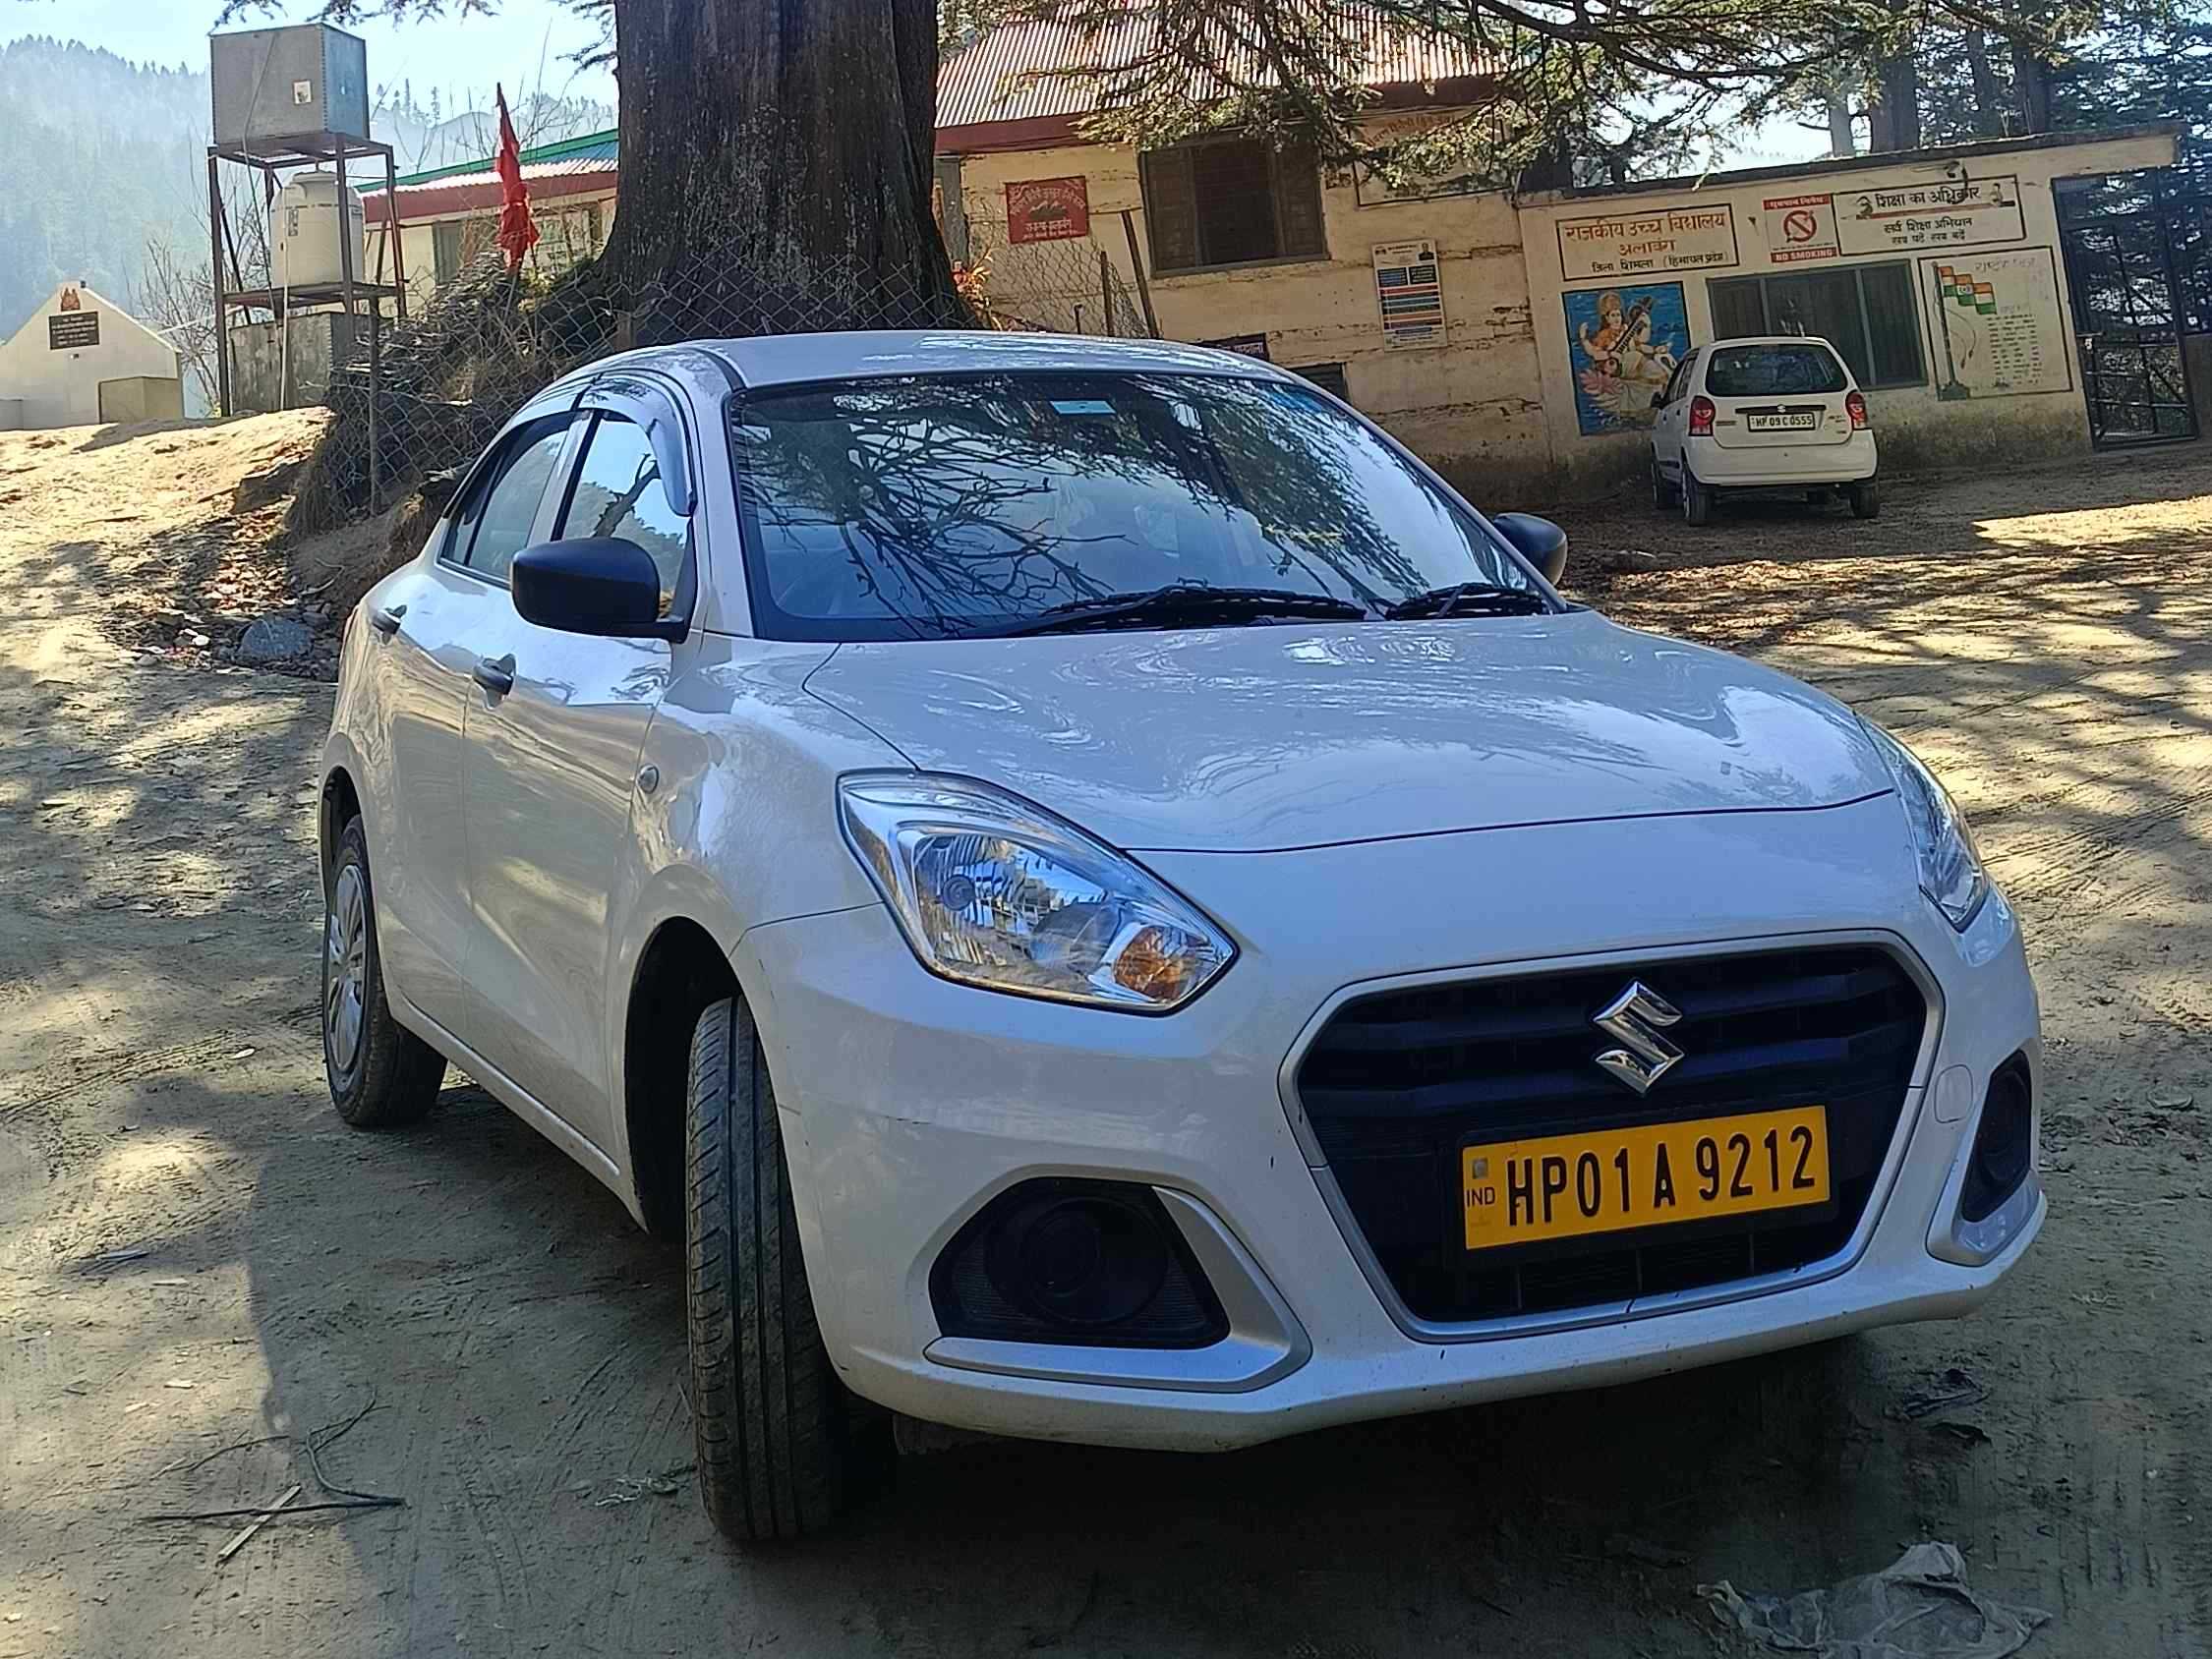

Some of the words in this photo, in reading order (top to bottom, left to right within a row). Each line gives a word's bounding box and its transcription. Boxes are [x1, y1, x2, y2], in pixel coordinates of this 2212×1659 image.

[1875, 192, 1905, 208] शिक्षा
[1909, 191, 1926, 204] का
[1565, 217, 1624, 242] राजकीय
[1628, 218, 1663, 237] उच्च
[1667, 211, 1725, 233] विद्यालय
[1906, 218, 1932, 232] शिक्षा
[1934, 215, 1973, 229] अभियान
[1620, 257, 1654, 270] शिमला
[1775, 253, 1789, 261] NO
[1790, 250, 1833, 260] SMOKING
[1506, 1146, 1631, 1227] HP01
[1653, 1142, 1676, 1209] A
[1694, 1124, 1816, 1201] 9212
[1466, 1186, 1496, 1209] IND
